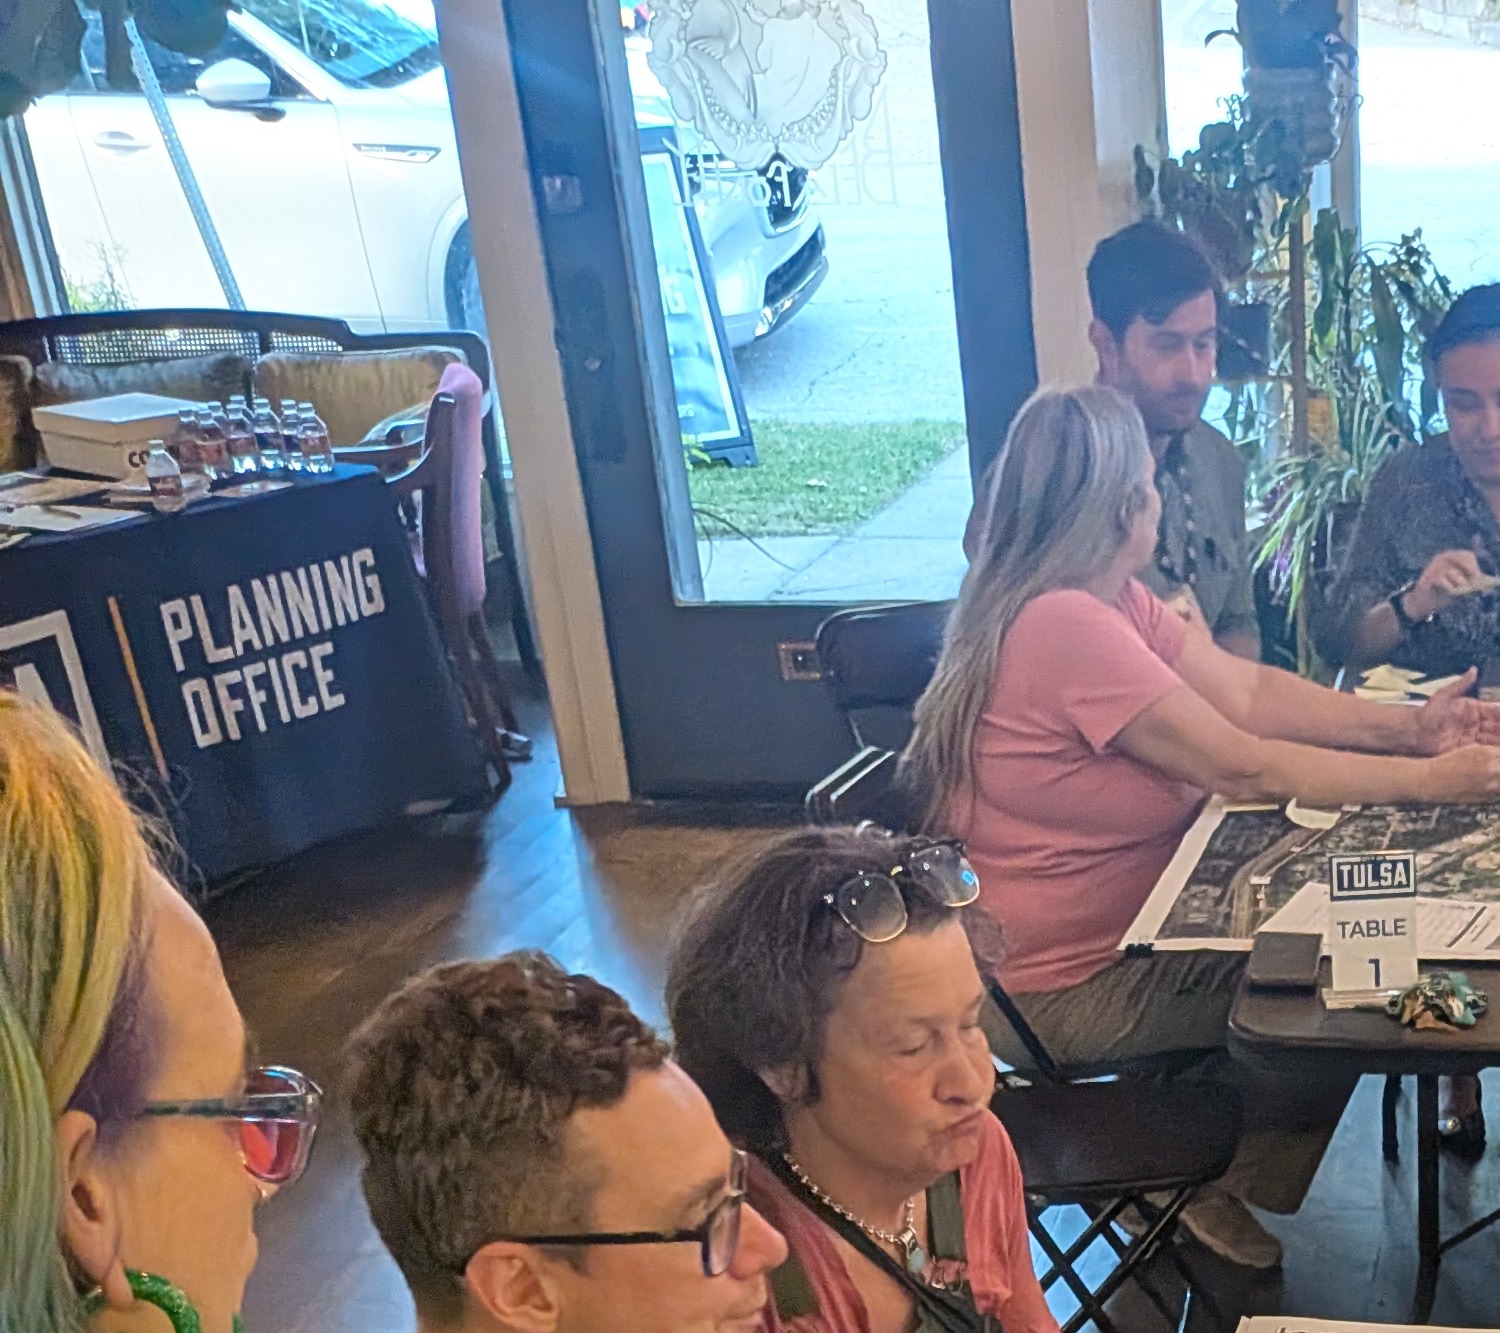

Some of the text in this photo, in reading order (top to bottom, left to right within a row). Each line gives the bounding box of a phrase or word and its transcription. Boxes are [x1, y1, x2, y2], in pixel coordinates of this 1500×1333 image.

[160, 548, 385, 673] PLANNING
[182, 642, 346, 749] OFFICE
[1339, 862, 1408, 891] TULSA
[1337, 919, 1407, 940] TABLE
[1368, 959, 1381, 987] 1
